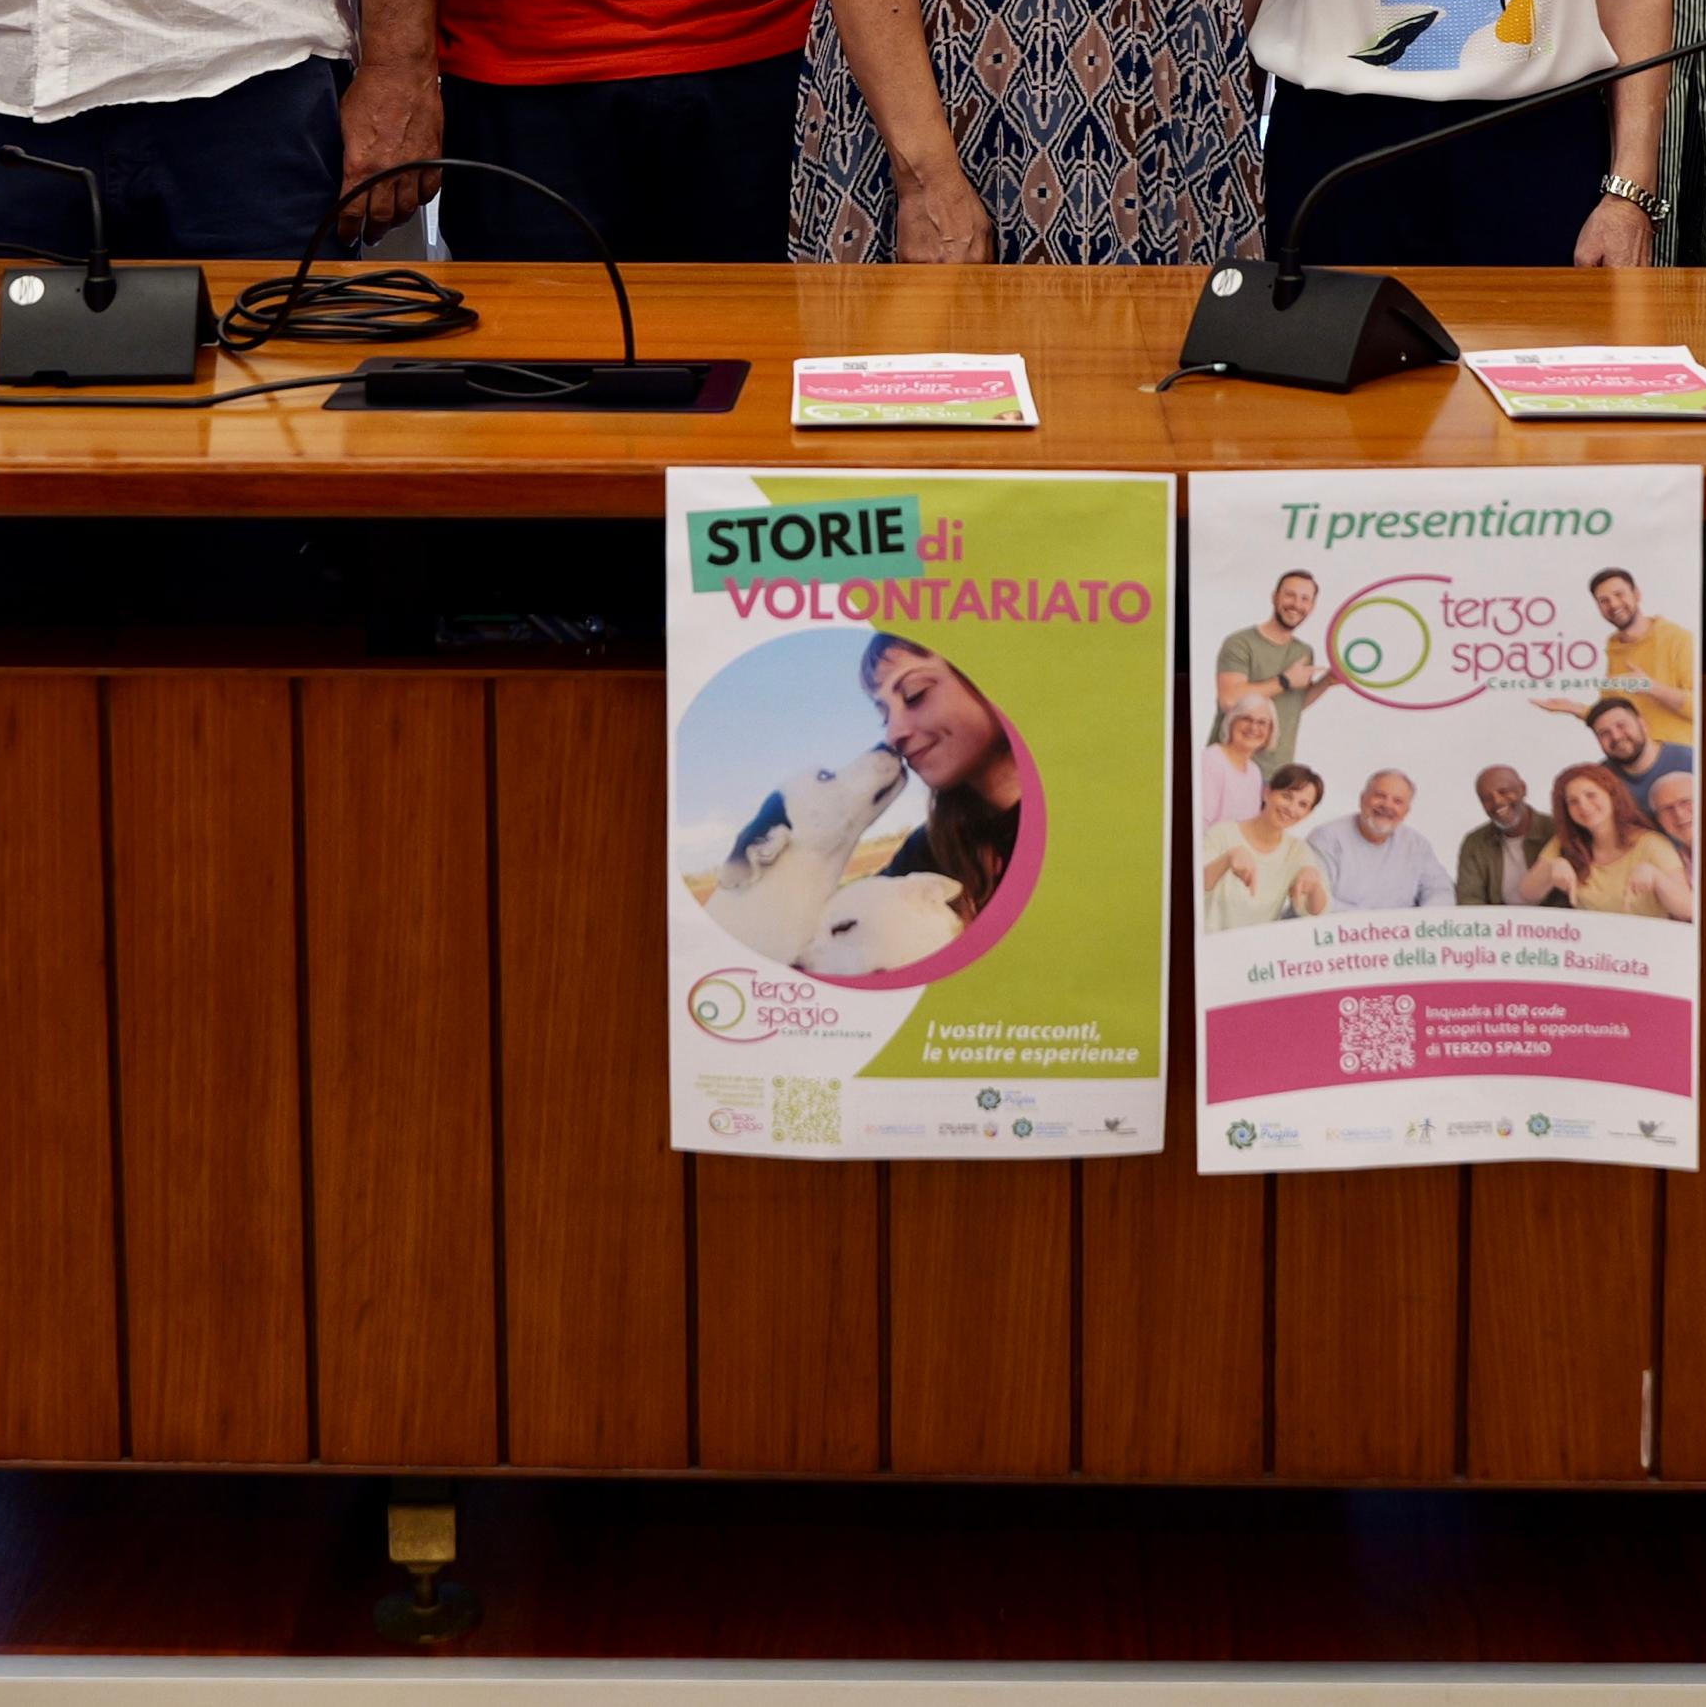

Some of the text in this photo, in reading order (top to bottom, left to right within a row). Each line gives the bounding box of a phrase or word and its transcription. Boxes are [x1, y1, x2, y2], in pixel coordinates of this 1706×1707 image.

[706, 507, 964, 566] STORIE di
[1281, 500, 1613, 549] Ti presentiamo
[724, 577, 1152, 624] VOLONTARIATO
[1440, 591, 1556, 636] terzo
[1451, 632, 1598, 680] spazio
[1487, 677, 1537, 689] Cerca
[1561, 677, 1651, 691] partecipa
[1314, 920, 1581, 946] La bacheca dedicata al mondo
[1247, 947, 1650, 984] del Terzo settore della Puglia e della Basilicata
[750, 978, 816, 1003] terzo
[757, 1003, 839, 1029] spazio
[1425, 1004, 1567, 1021] Inquadra il QR code
[927, 1021, 1101, 1043] I vostri racconti,
[1425, 1022, 1631, 1041] e scopri tutte le opportunità
[922, 1044, 1140, 1066] le vostre esperienze
[1425, 1041, 1551, 1057] di TERZO SPAZIO
